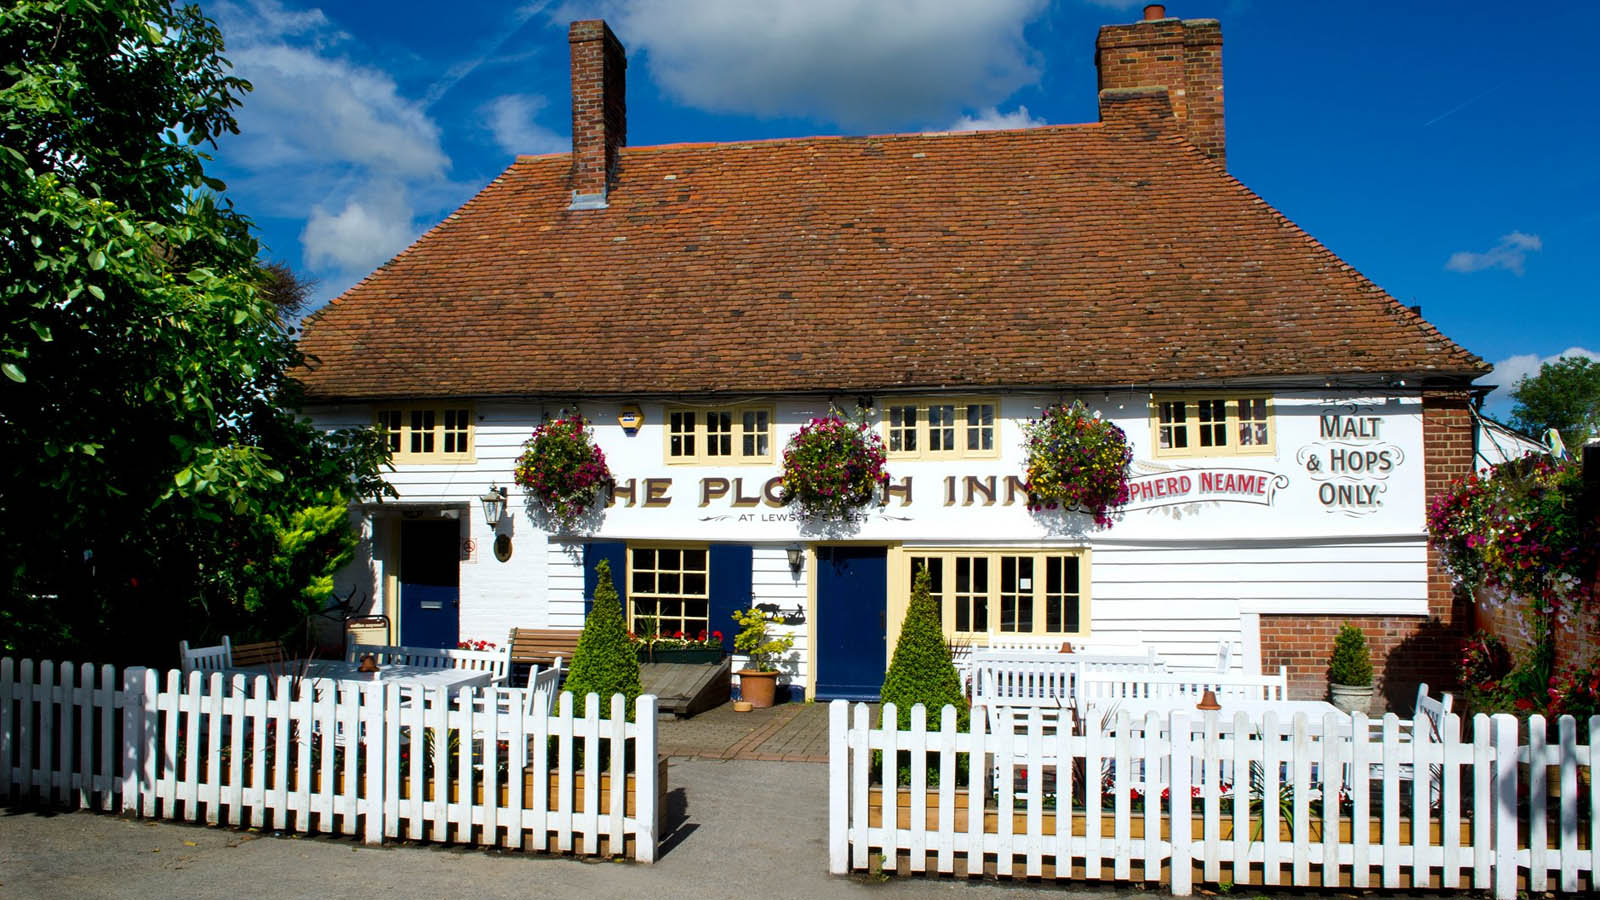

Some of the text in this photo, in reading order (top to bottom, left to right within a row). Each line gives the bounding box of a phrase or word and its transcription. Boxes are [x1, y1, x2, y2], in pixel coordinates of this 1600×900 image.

[1320, 415, 1381, 438] MALT
[1306, 449, 1392, 472] & HOPS
[605, 475, 1030, 508] HE PLOH INN
[1130, 472, 1268, 500] PHERD NEAME
[738, 513, 755, 522] AT
